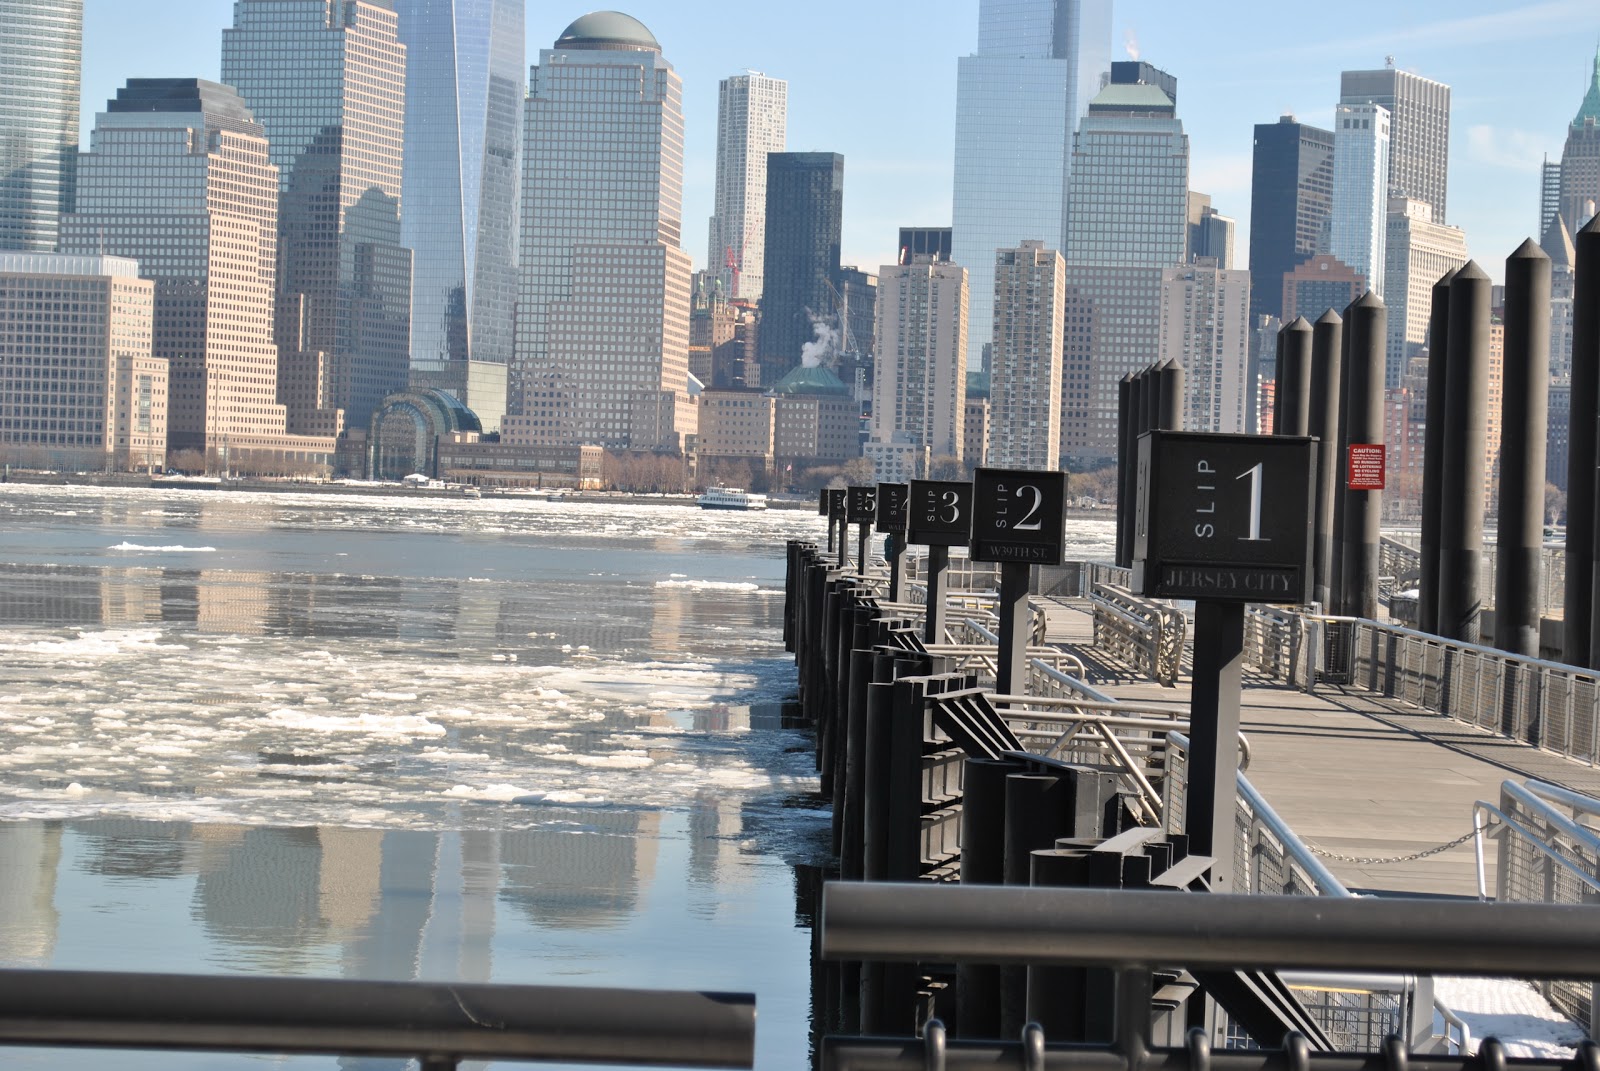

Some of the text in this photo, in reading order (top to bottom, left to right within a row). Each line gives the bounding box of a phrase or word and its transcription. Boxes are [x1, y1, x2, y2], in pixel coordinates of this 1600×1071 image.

[864, 492, 876, 512] 5
[927, 490, 936, 522] SLIP
[940, 491, 960, 524] 3
[996, 484, 1042, 530] SLIP 2
[1195, 459, 1216, 538] SLIP
[1235, 462, 1272, 542] 1
[1166, 570, 1294, 591] JERSEY CITY
